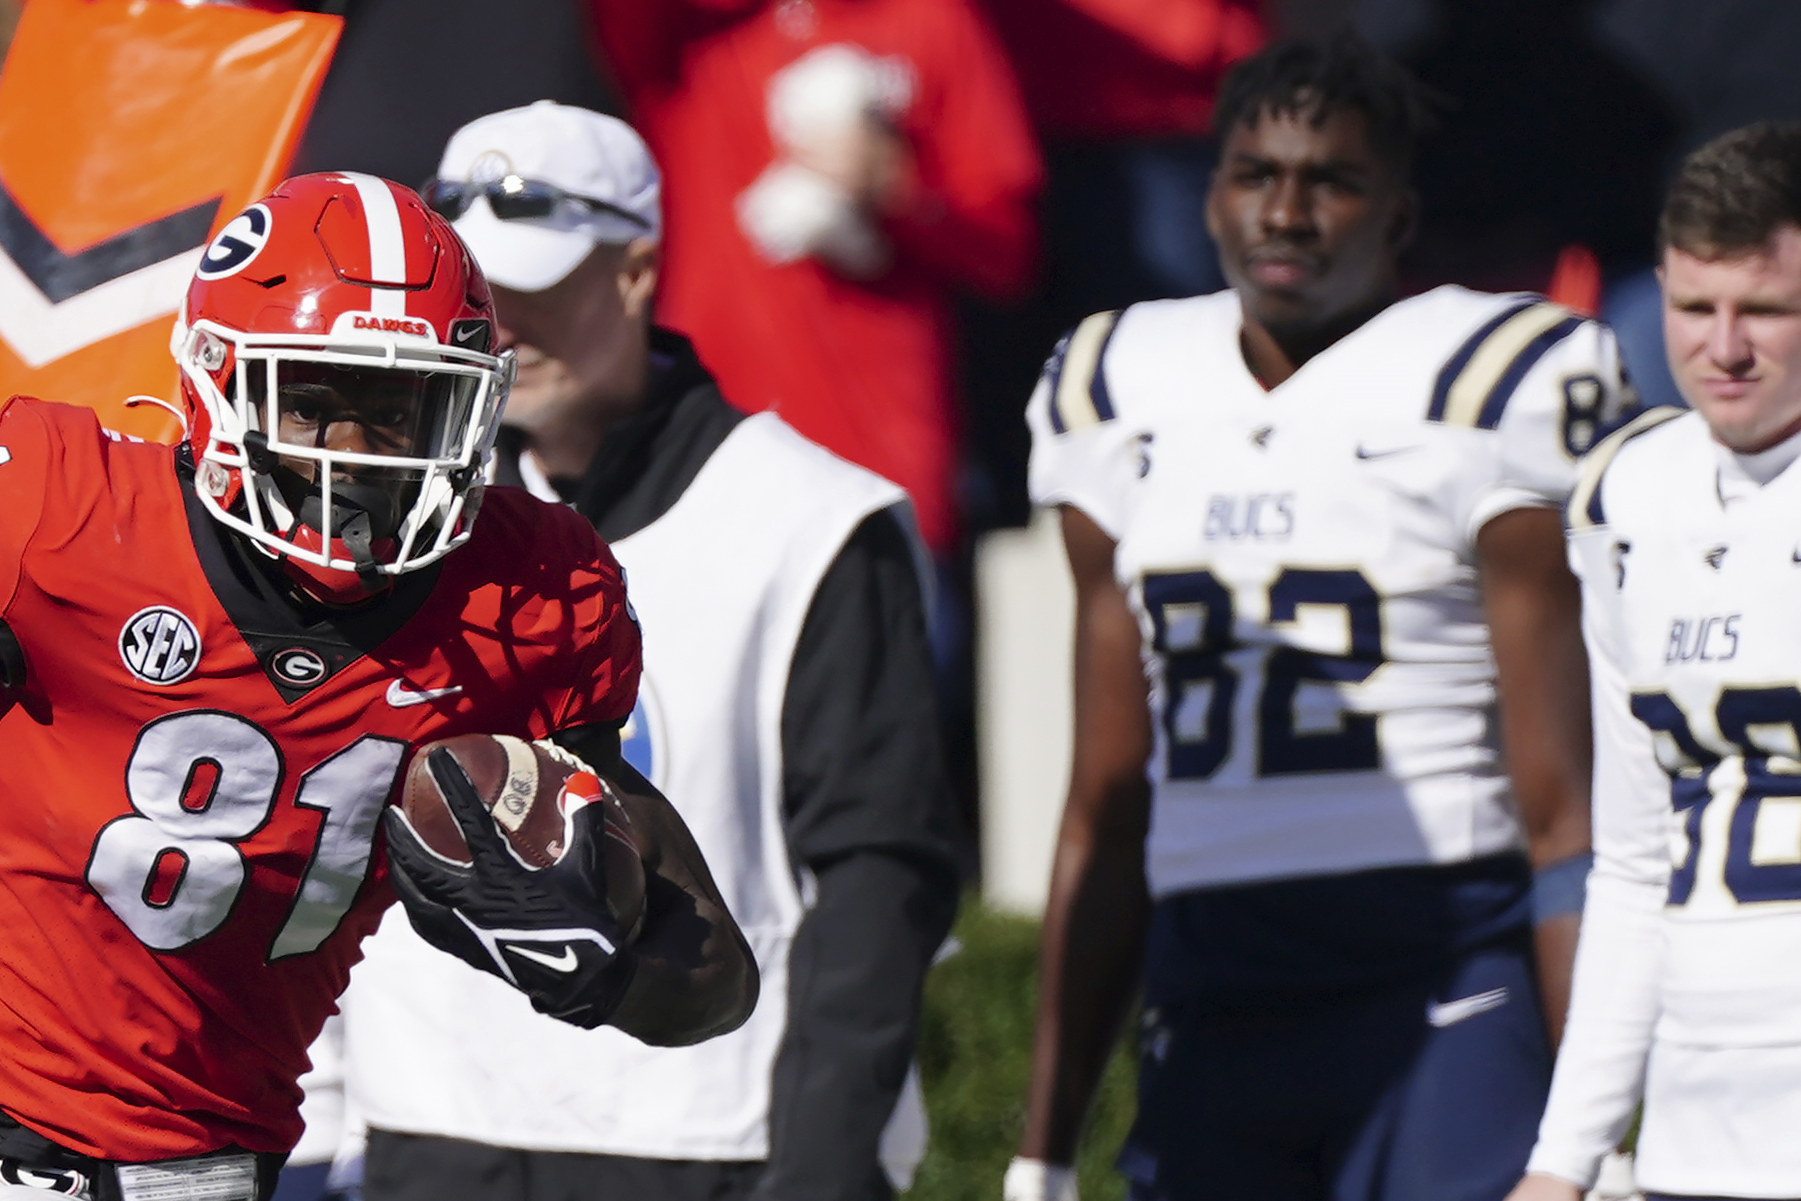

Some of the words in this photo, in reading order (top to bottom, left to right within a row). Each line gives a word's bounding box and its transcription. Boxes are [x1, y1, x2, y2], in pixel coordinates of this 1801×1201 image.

[352, 316, 430, 338] DAWGS
[1201, 491, 1302, 541] BUCS
[124, 610, 196, 682] SEC
[1662, 611, 1743, 667] BUCS
[1140, 563, 1388, 782] 82
[84, 707, 410, 966] 81
